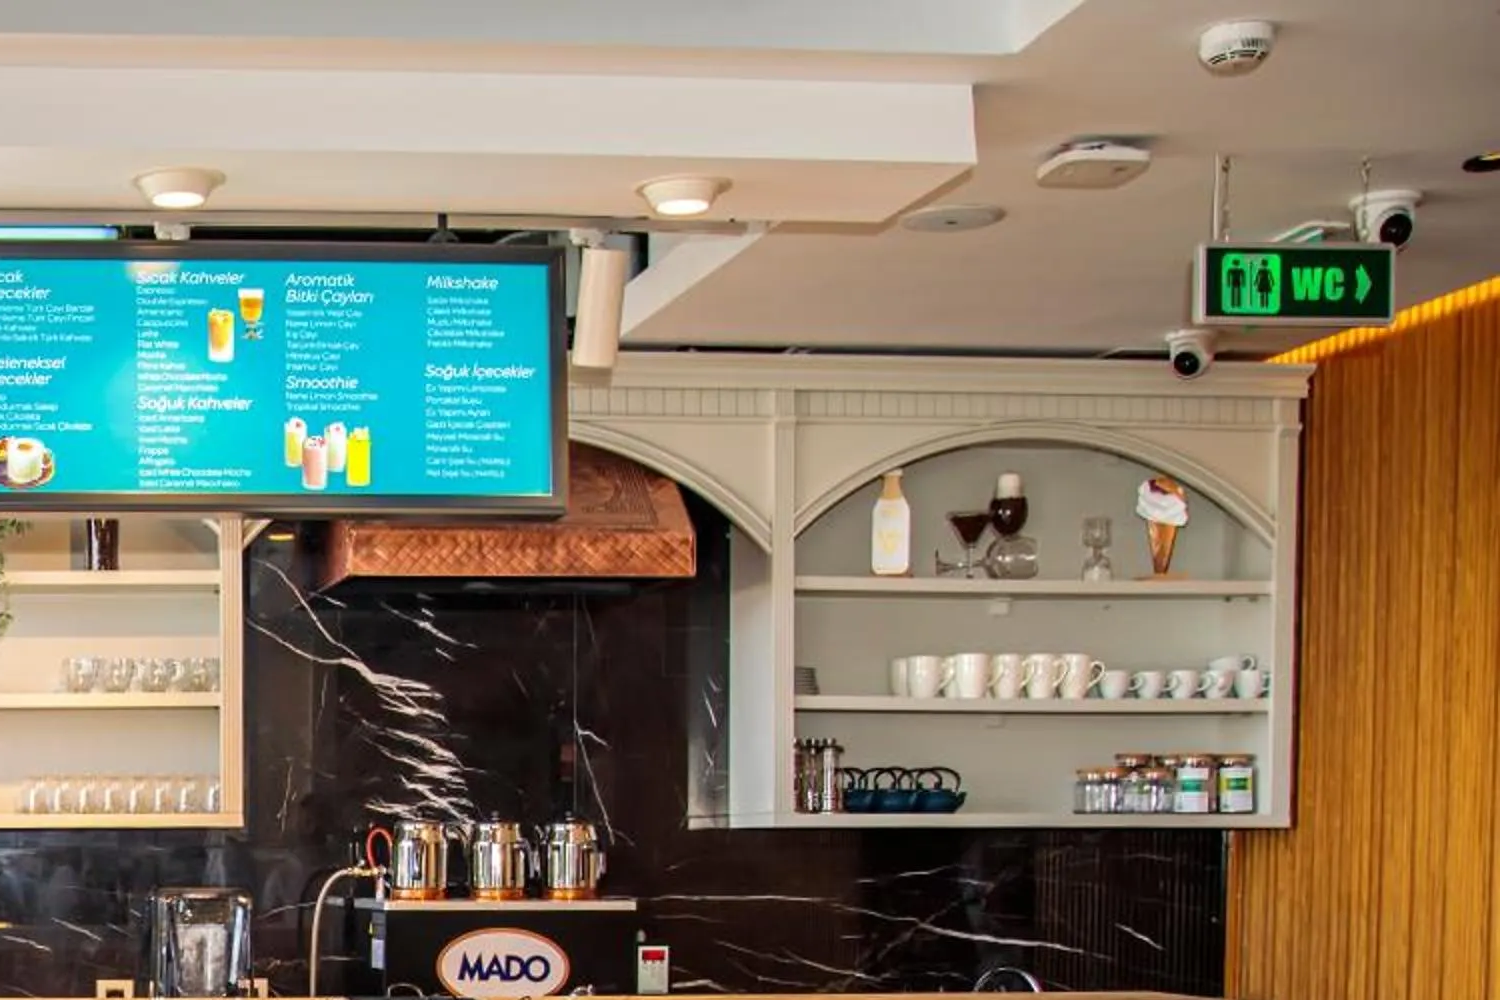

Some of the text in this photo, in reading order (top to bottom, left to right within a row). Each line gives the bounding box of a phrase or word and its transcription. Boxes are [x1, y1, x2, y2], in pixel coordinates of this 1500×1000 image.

[180, 271, 246, 285] Kahveler
[285, 273, 355, 287] Aromatik
[426, 275, 498, 290] Milkshake
[1291, 266, 1345, 301] WC
[285, 289, 319, 303] Bitki
[286, 375, 358, 389] Smoothie
[187, 395, 253, 411] Kahveler
[457, 951, 551, 983] MADO
